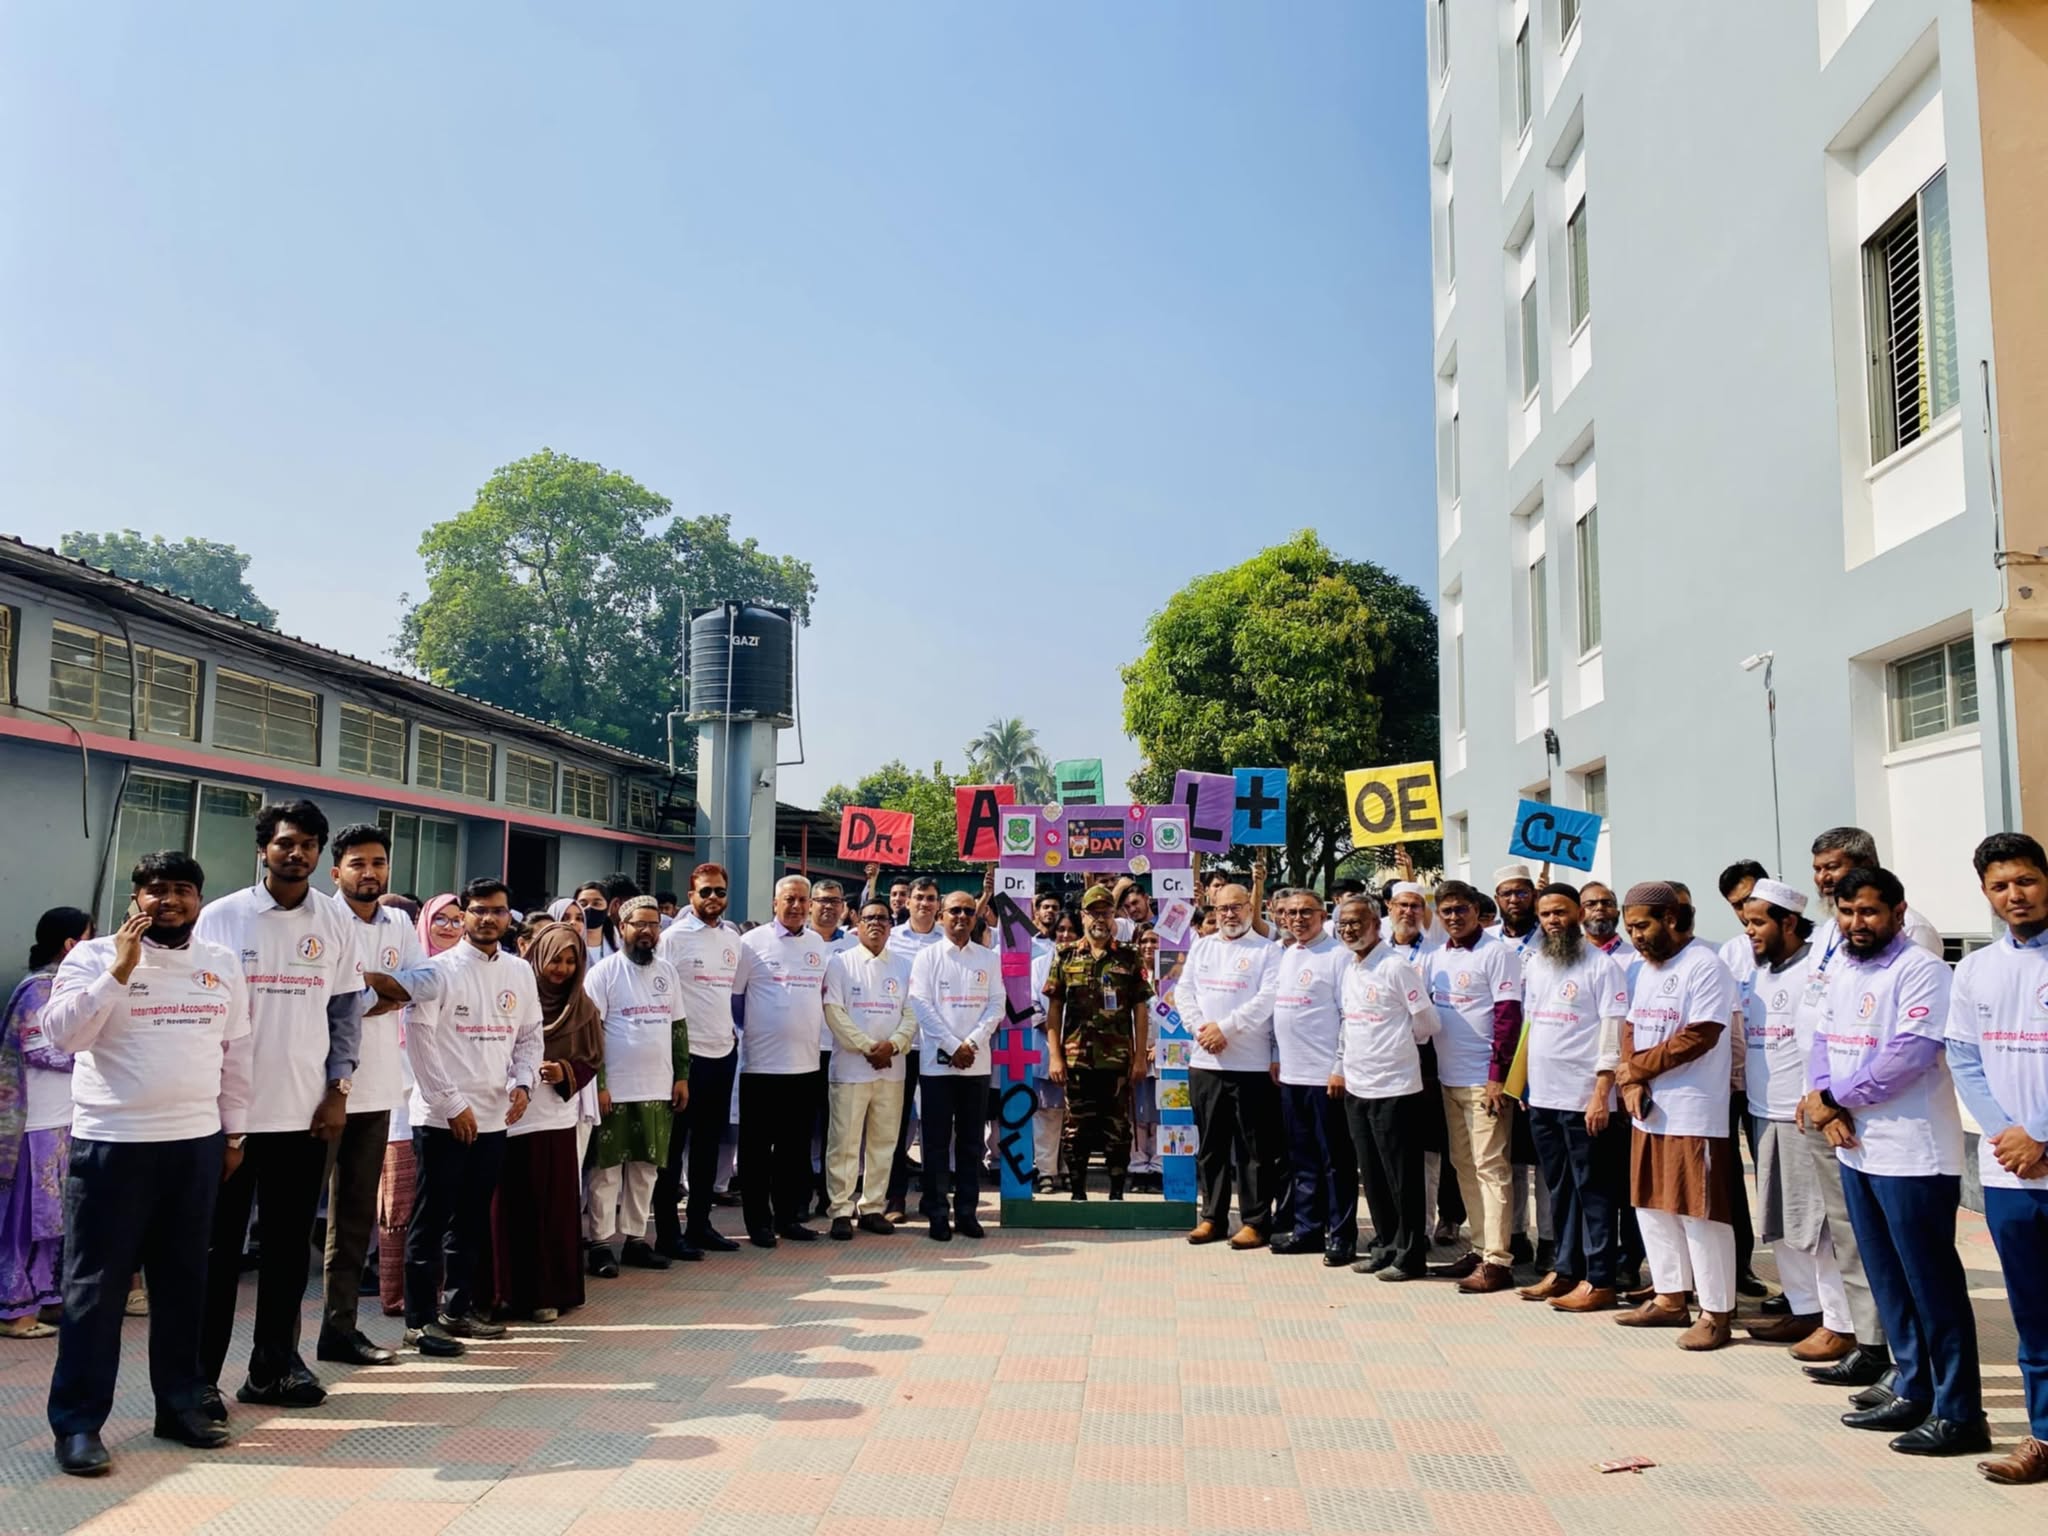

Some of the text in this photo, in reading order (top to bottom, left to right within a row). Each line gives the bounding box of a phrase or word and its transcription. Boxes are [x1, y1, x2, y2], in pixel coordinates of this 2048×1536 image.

[732, 635, 760, 647] GAZI
[1355, 774, 1437, 834] OE
[1186, 783, 1223, 841] L
[963, 790, 999, 855] A
[848, 813, 903, 854] Dr.
[1521, 812, 1587, 862] Cr.
[1090, 838, 1123, 851] DAY
[1005, 877, 1025, 890] Dr.
[1163, 879, 1184, 892] Cr.
[280, 974, 312, 987] Accounting
[313, 976, 324, 988] Day
[131, 1004, 179, 1016] International
[180, 1003, 219, 1016] Accounting
[1782, 1025, 1795, 1038] Day
[1865, 1035, 1878, 1048] Day
[2007, 1046, 2038, 1054] November
